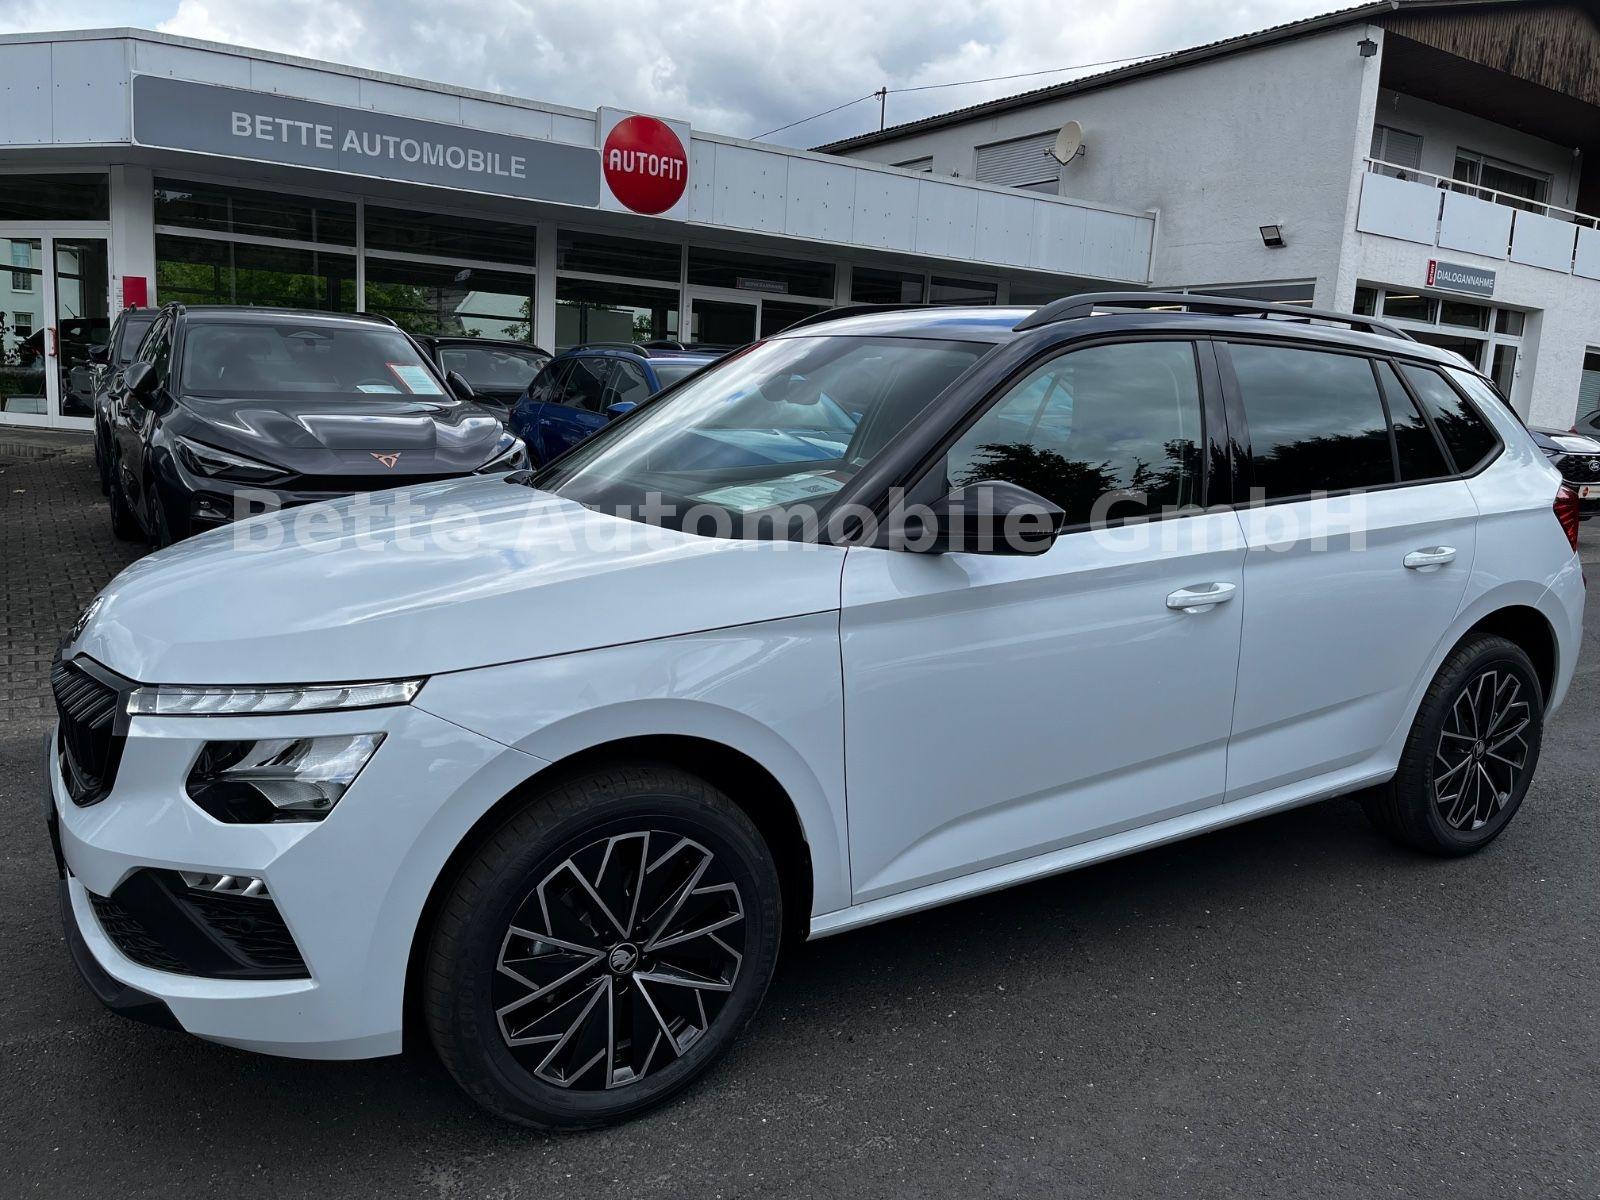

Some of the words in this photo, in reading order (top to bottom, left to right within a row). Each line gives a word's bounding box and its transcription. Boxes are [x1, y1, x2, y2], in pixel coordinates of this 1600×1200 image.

[231, 111, 334, 149] BETTE
[341, 129, 527, 179] AUTOMOBILE
[609, 148, 684, 181] AUTOFIT
[1437, 270, 1494, 288] DIALOGANNAHME
